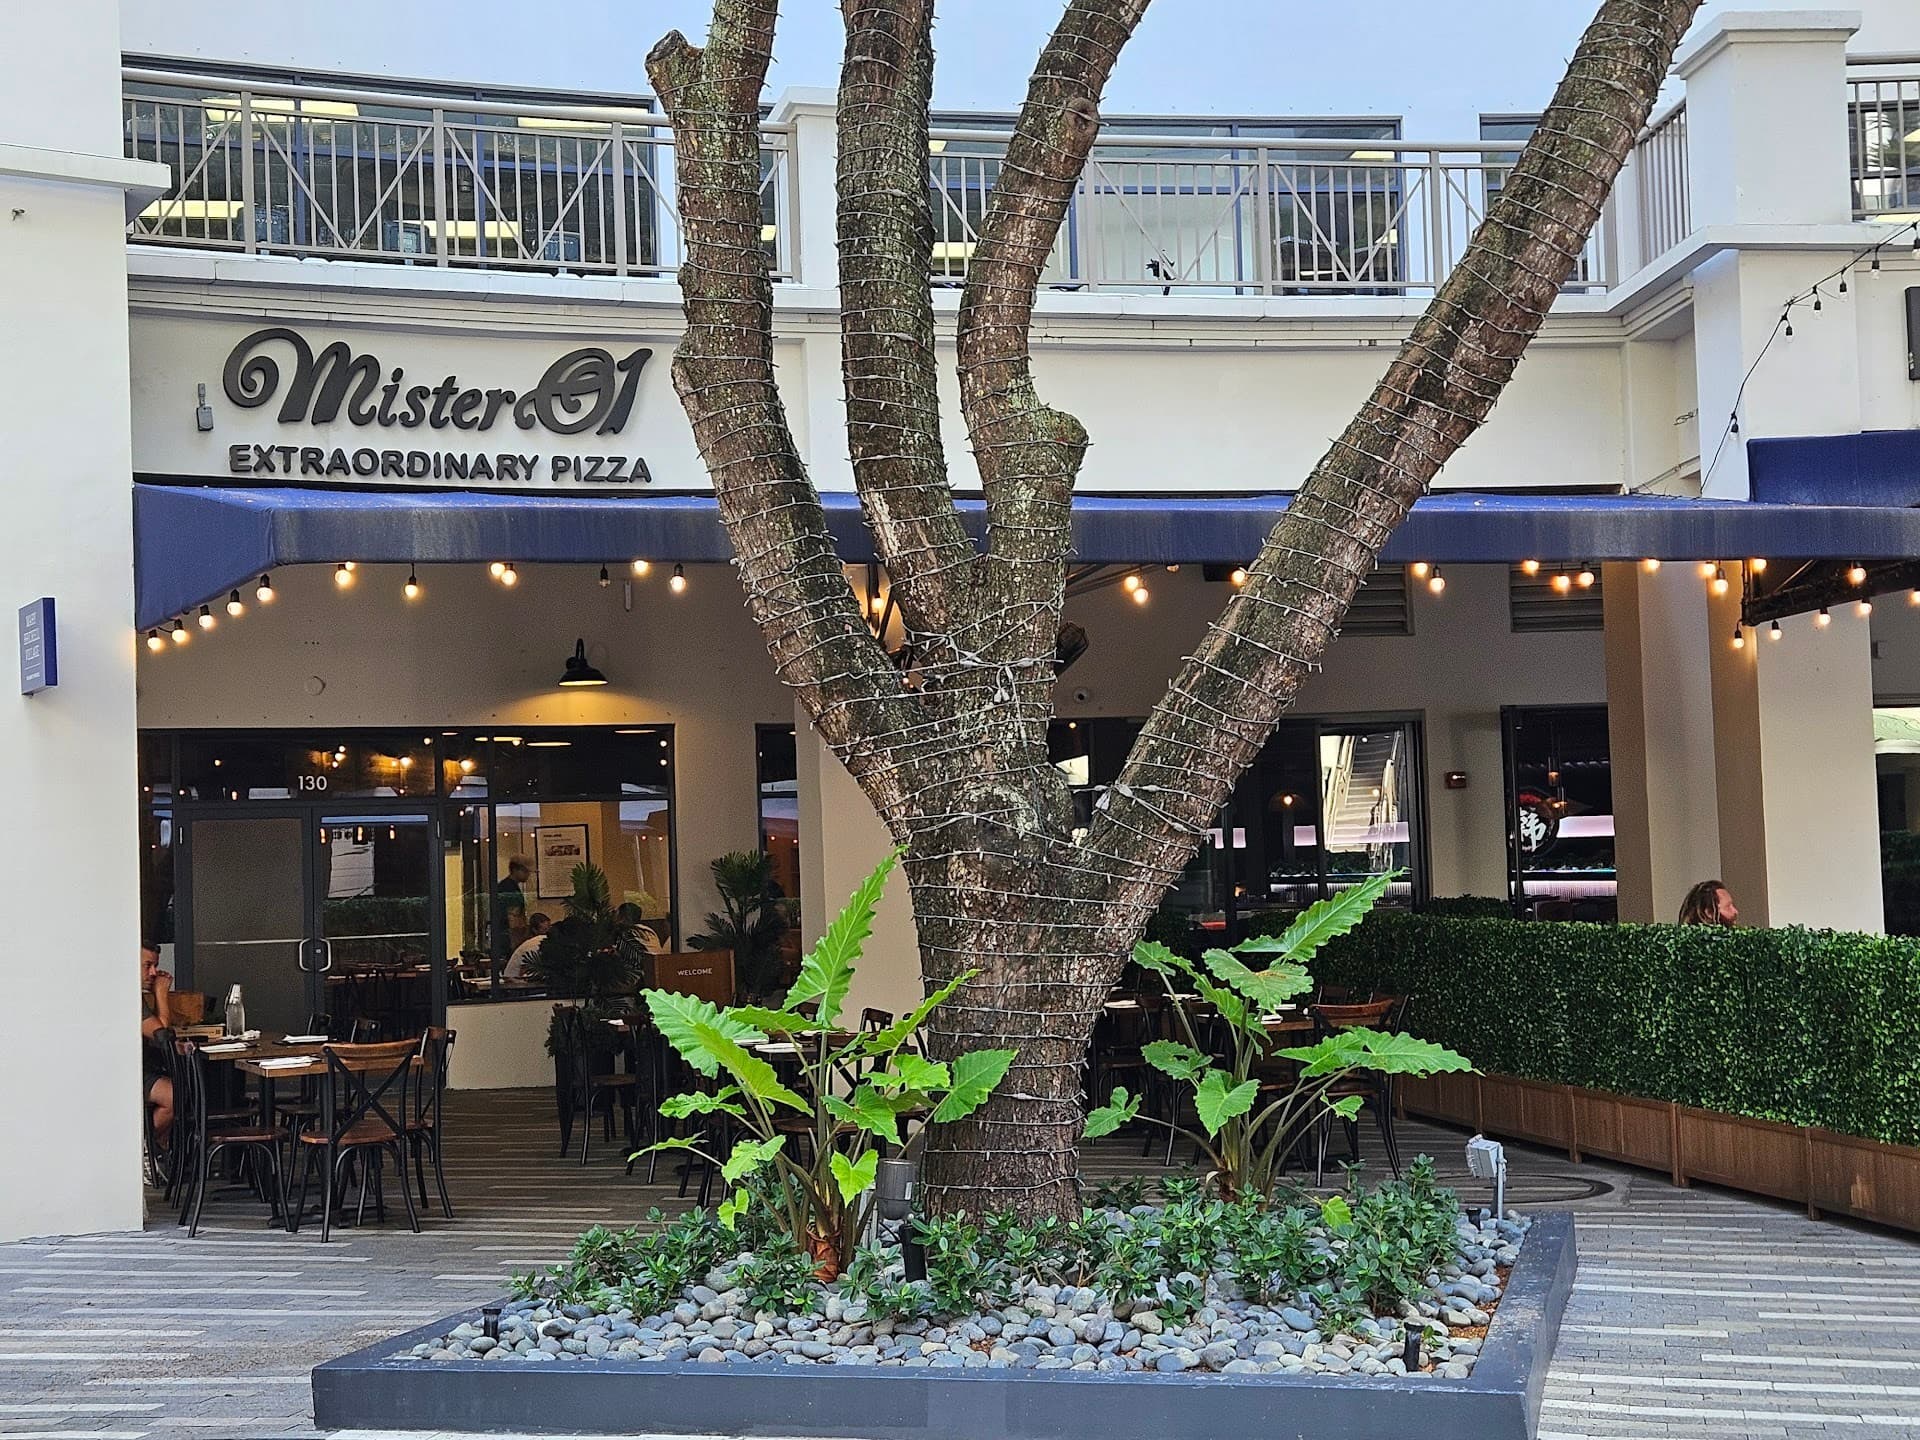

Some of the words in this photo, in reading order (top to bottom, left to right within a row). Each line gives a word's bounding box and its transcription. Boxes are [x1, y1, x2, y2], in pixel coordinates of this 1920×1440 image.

[222, 327, 516, 431] Mister
[229, 444, 539, 482] EXTRAORDINARY
[551, 455, 652, 483] PIZZA
[298, 775, 328, 791] 130
[677, 967, 713, 976] WELCOME
